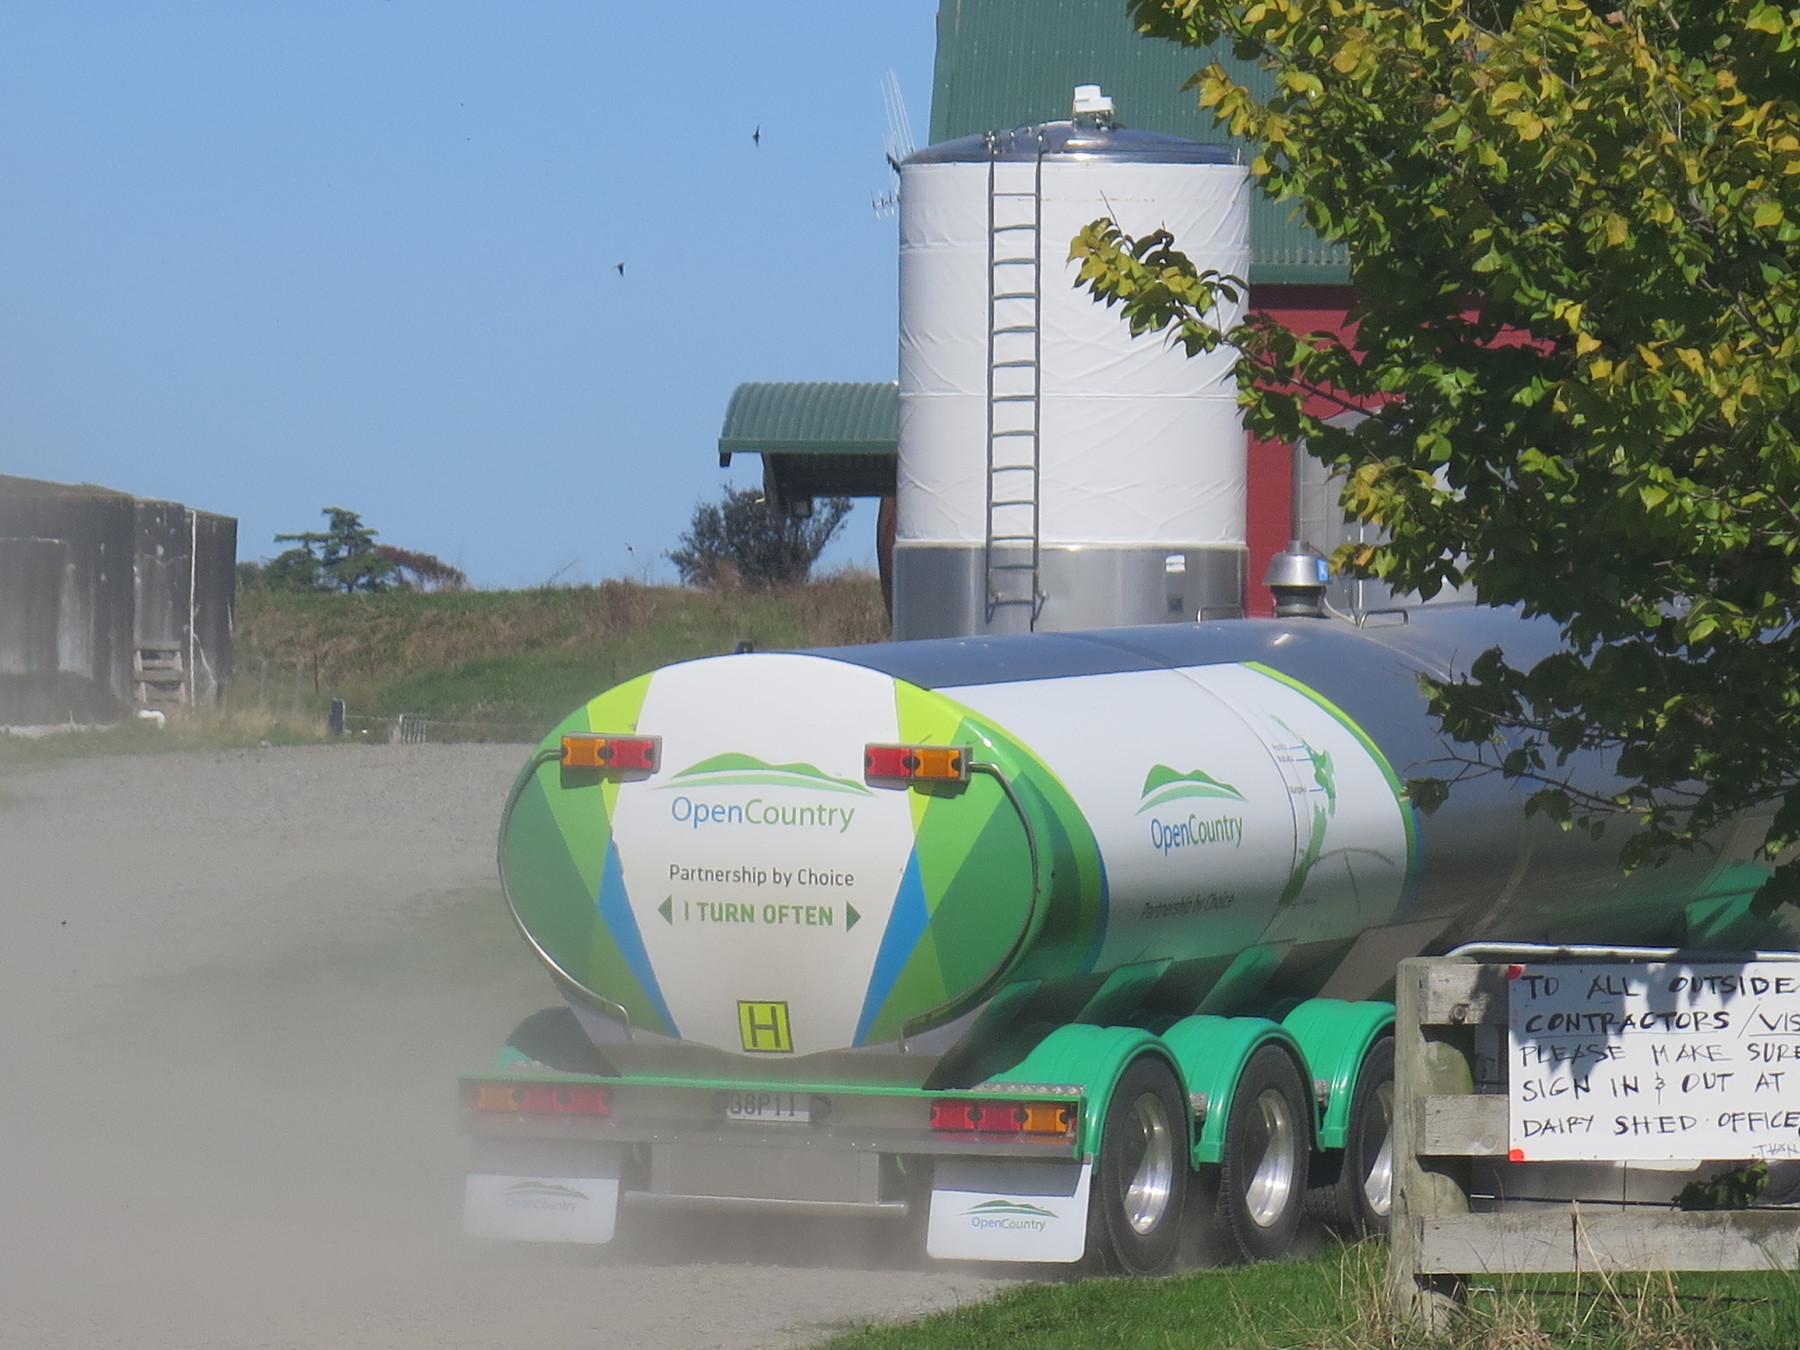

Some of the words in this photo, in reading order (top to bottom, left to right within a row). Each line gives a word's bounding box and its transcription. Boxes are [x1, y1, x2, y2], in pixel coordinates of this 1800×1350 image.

[671, 796, 855, 834] OpenCountry
[1150, 813, 1243, 856] OpenCountry
[669, 864, 767, 887] Partnership
[772, 868, 793, 888] by
[797, 868, 855, 887] Choice
[684, 901, 690, 921] I
[696, 902, 755, 924] TURN
[762, 904, 834, 927] OFTEN
[1520, 974, 1560, 1000] TO
[1586, 976, 1641, 998] ALL
[1668, 975, 1800, 998] OUTSIDE
[748, 1004, 782, 1049] H
[1525, 1010, 1731, 1035] CONTRACTORS
[1520, 1044, 1627, 1067] PLEASE
[1651, 1043, 1733, 1066] MAKE
[1522, 1074, 1591, 1102] SIGN
[1611, 1075, 1640, 1098] IN
[1682, 1072, 1735, 1094] OUT
[1754, 1072, 1786, 1093] AT
[1522, 1114, 1595, 1138] DAIRY
[1613, 1115, 1697, 1136] SHED
[1718, 1110, 1800, 1134] OFFICE
[971, 1216, 1047, 1232] OpenCountry
